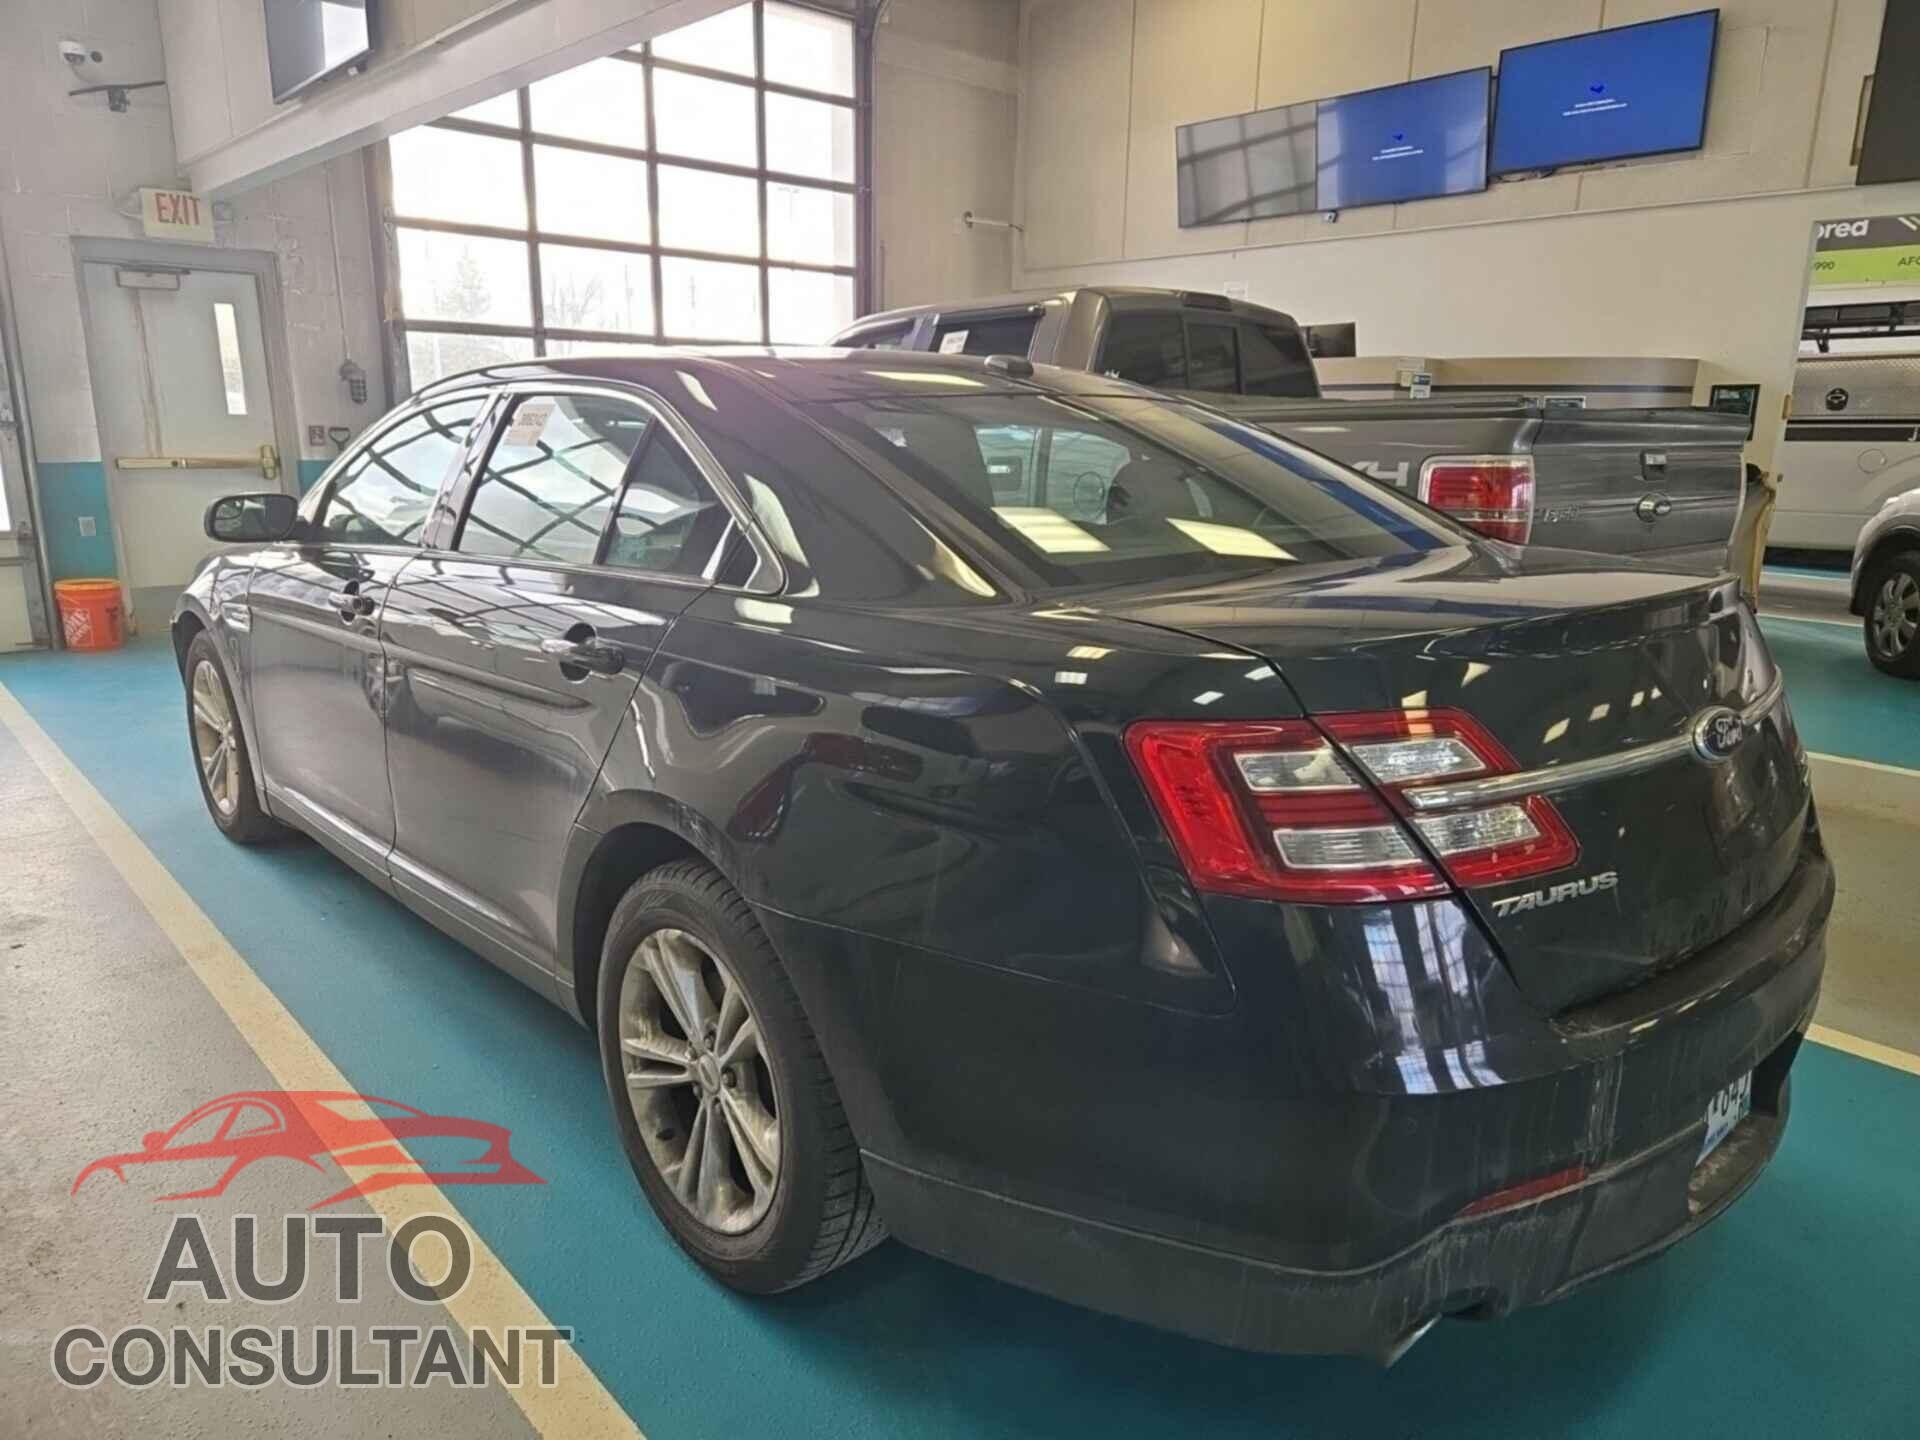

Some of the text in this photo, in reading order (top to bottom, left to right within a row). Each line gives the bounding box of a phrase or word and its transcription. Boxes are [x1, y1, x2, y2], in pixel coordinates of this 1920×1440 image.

[154, 192, 201, 226] EXIT
[1714, 717, 1743, 749] Ford
[1492, 870, 1619, 918] TAURUS
